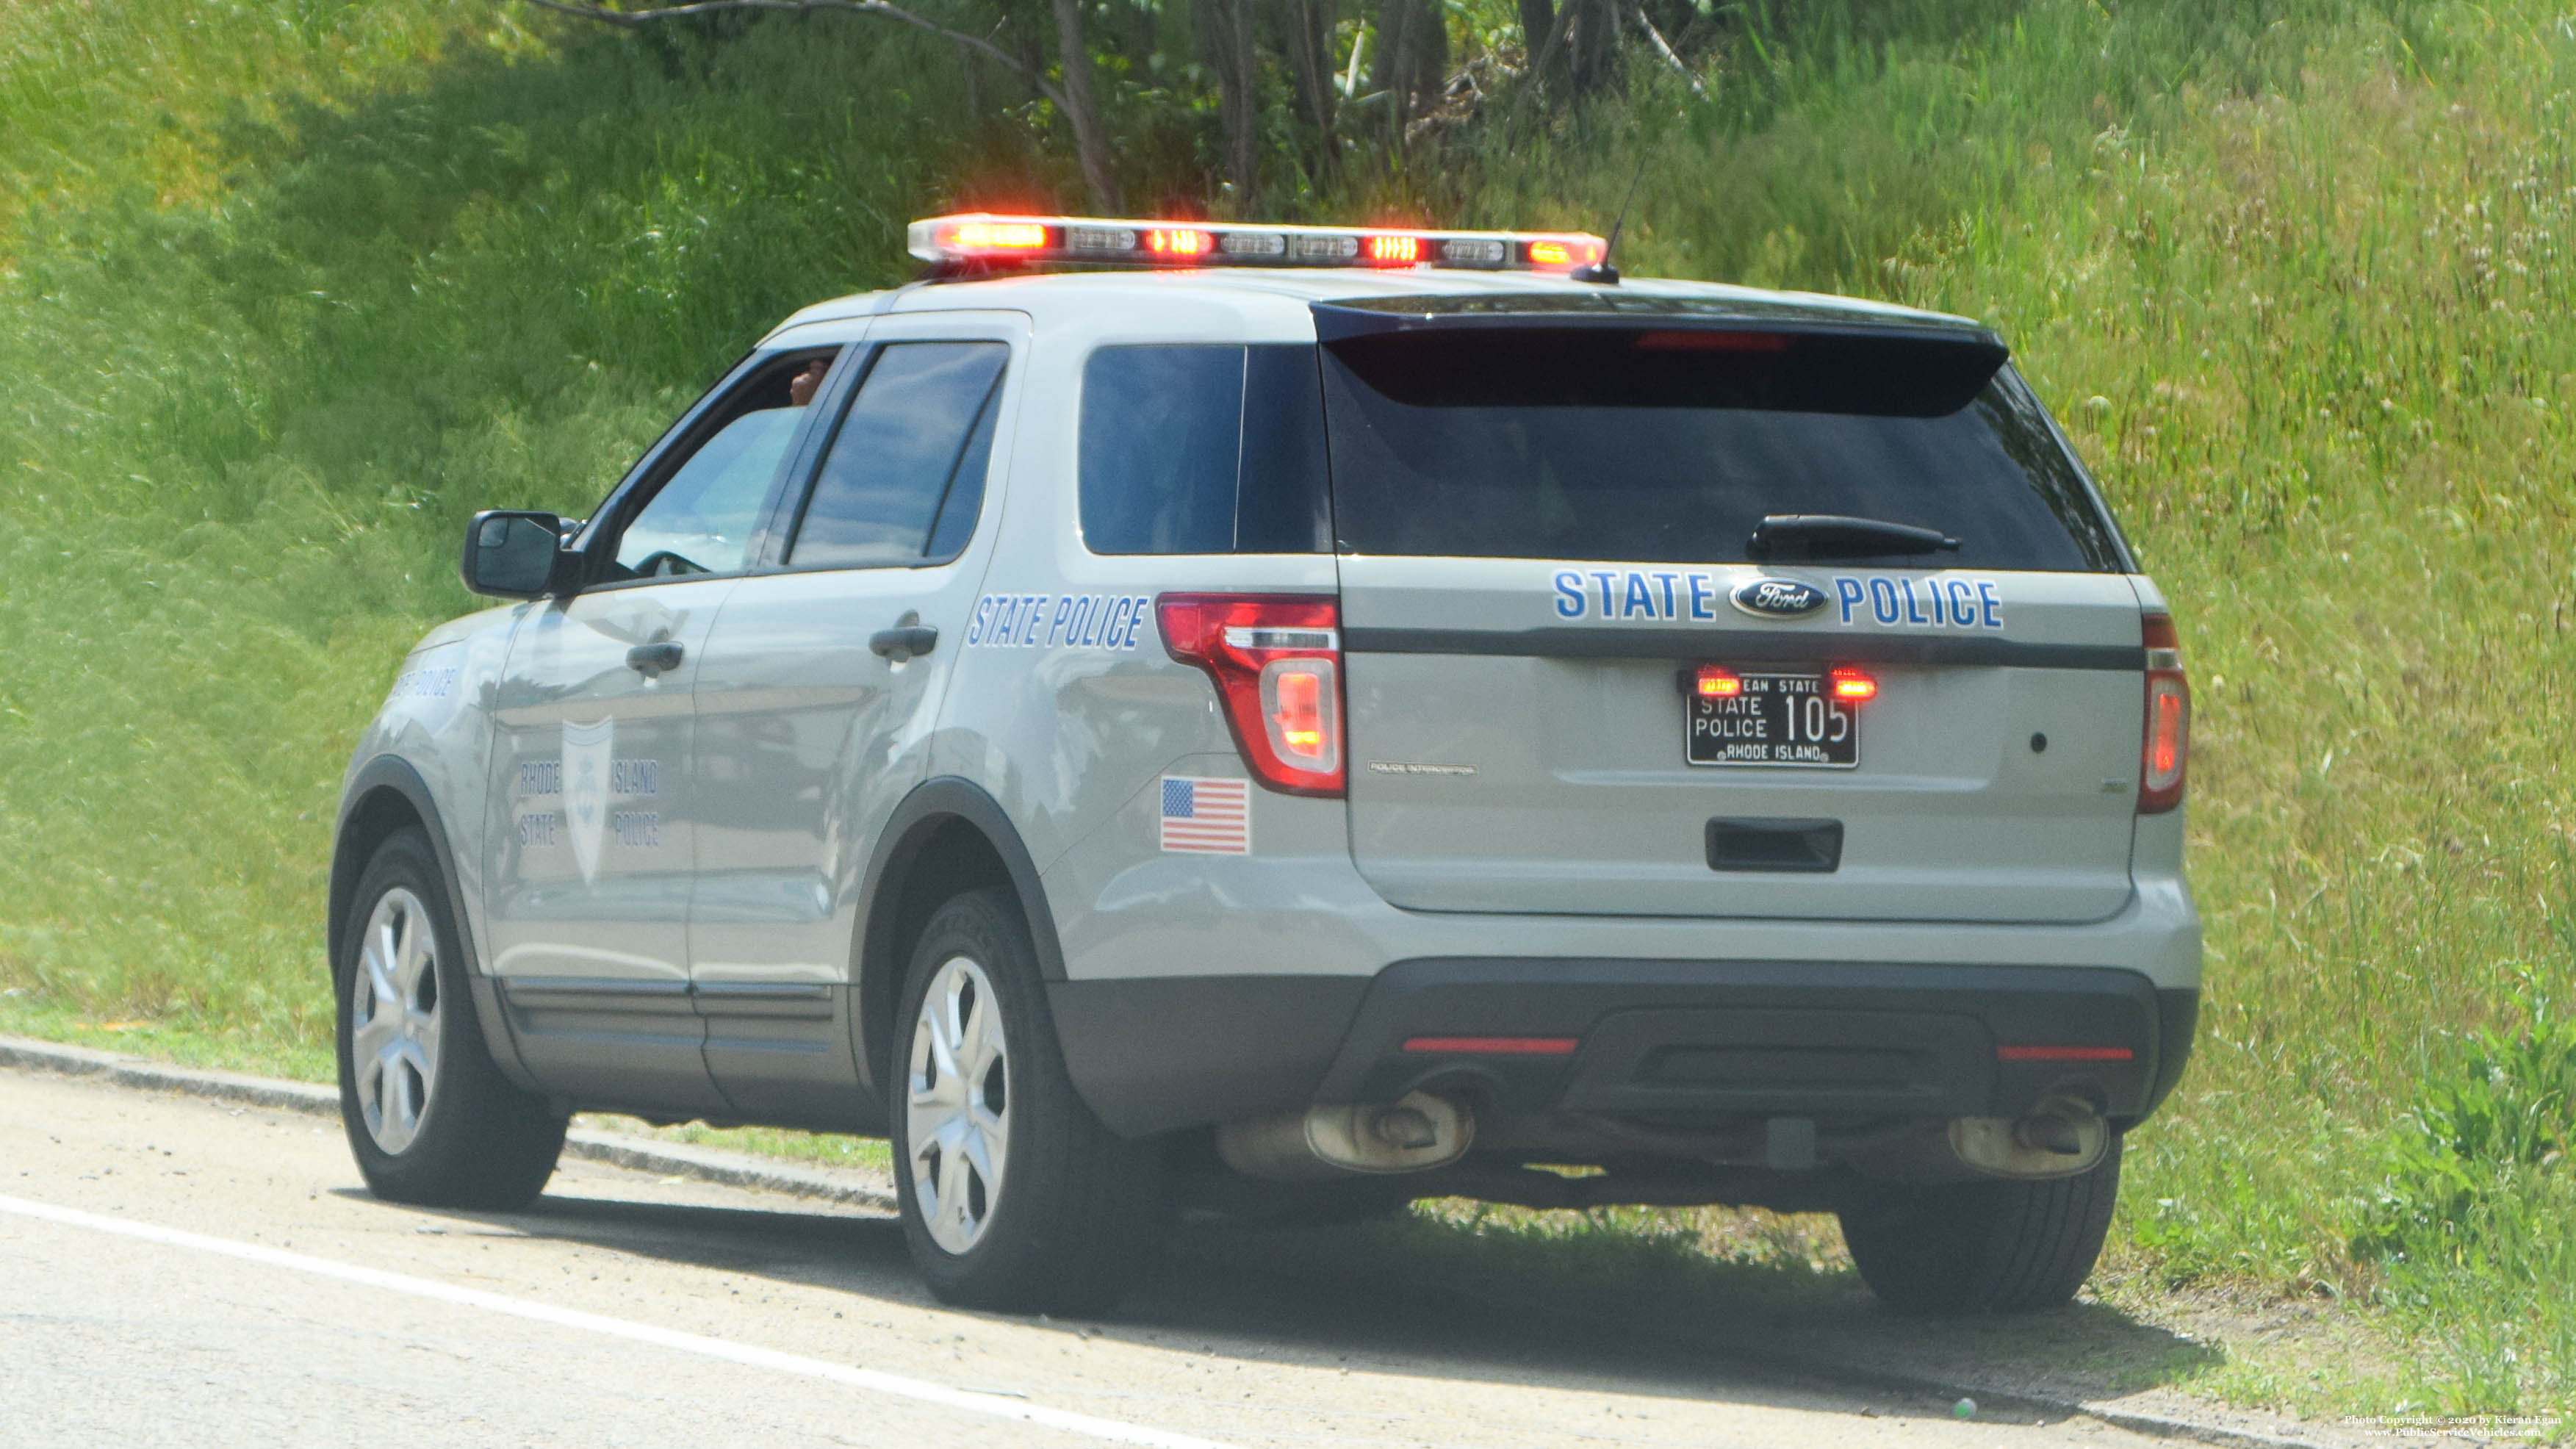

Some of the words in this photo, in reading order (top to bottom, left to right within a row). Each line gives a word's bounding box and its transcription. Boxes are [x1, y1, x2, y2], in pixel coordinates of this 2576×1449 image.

[1553, 569, 1716, 622] STATE
[1755, 582, 1809, 610] Ford
[1833, 575, 2004, 630] POLICE
[968, 594, 1049, 648] STATE
[1046, 594, 1150, 650] POLICE
[1779, 680, 1820, 694] STATE
[1701, 696, 1763, 716] STATE
[1785, 694, 1848, 742] 105
[1696, 719, 1767, 738] POLICE
[1727, 744, 1769, 759] RHODE
[1774, 745, 1821, 761] ISLAND
[521, 759, 561, 796] RHODE
[611, 758, 658, 796] ISLAND
[520, 813, 555, 847] STATE
[614, 812, 659, 847] POLICE
